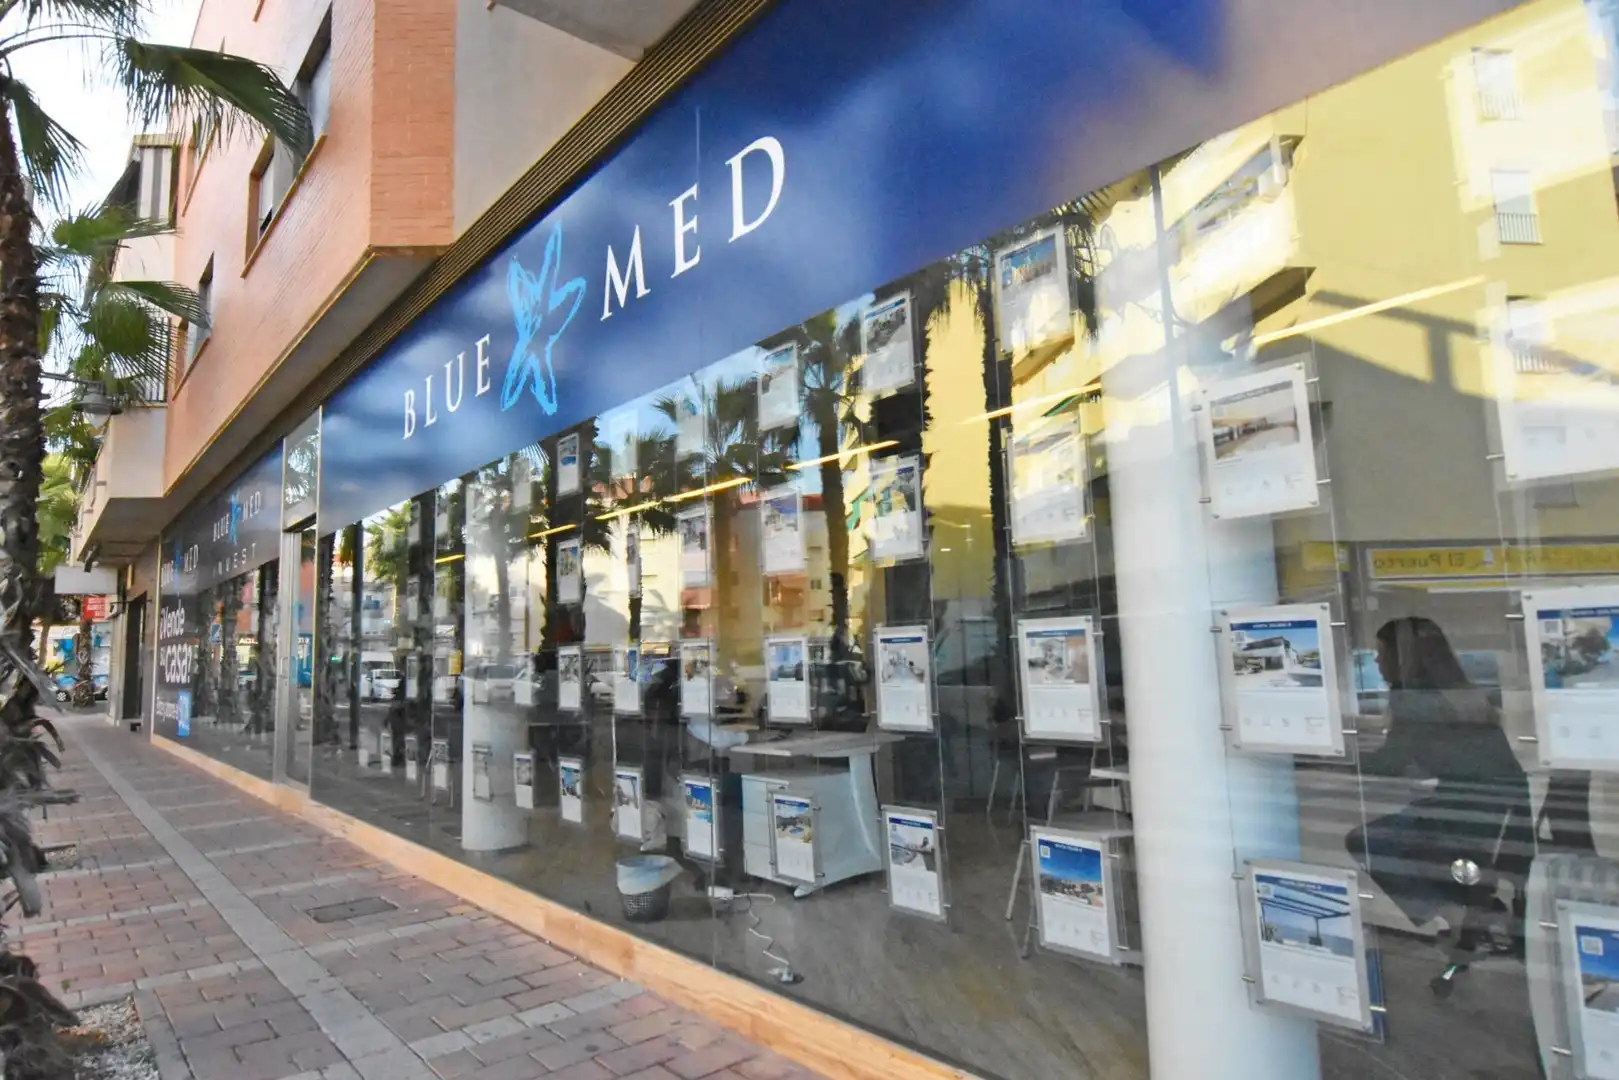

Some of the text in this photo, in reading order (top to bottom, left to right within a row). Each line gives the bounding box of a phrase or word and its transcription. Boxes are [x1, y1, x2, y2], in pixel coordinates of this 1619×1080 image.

[402, 135, 786, 441] BLUE MED
[212, 542, 257, 578] IVEST
[165, 643, 192, 684] casa?
